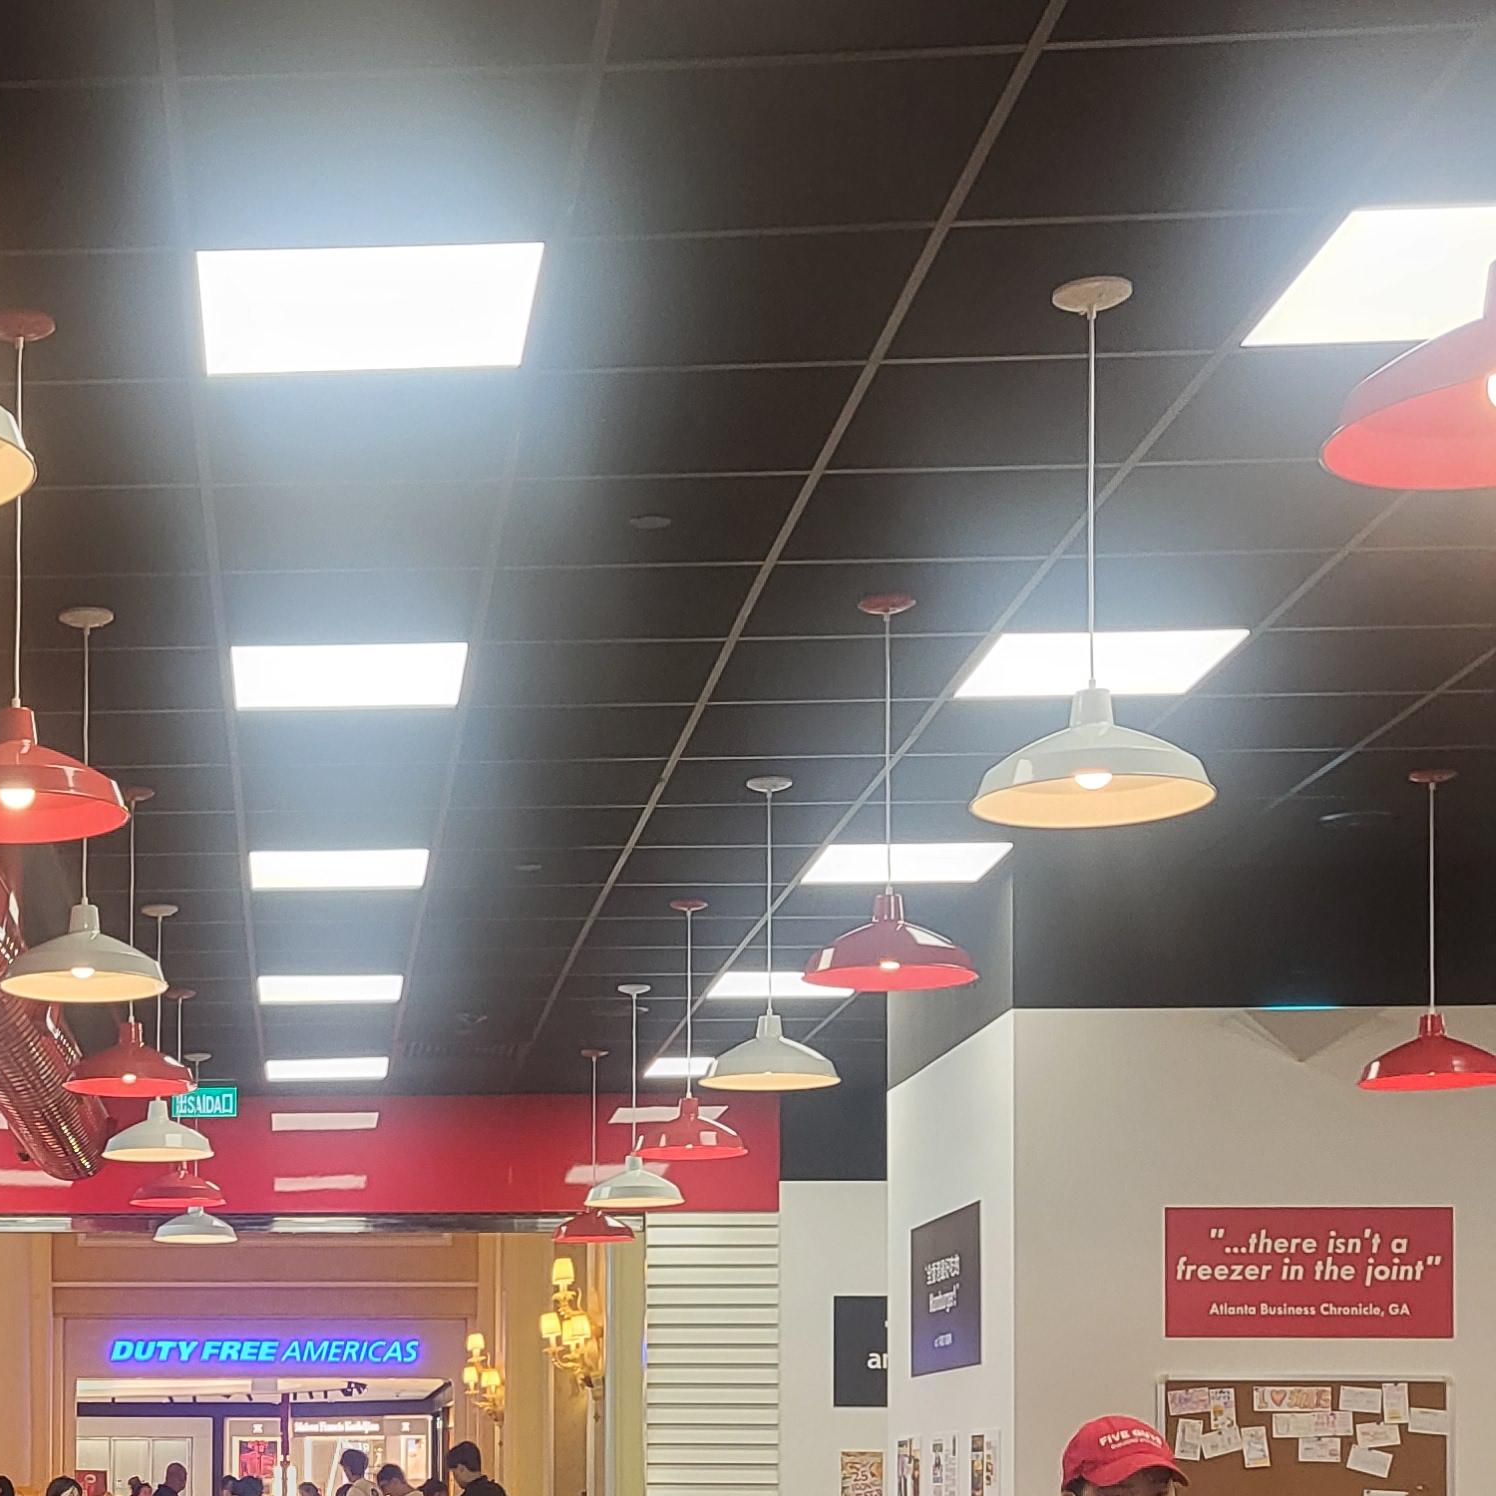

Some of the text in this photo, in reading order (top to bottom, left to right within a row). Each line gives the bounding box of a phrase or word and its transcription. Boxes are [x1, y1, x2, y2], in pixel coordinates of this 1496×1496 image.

[1327, 1228, 1381, 1254] isn't
[1391, 1238, 1408, 1254] a
[1176, 1256, 1272, 1281] freezer
[1281, 1257, 1304, 1281] in
[1314, 1256, 1356, 1281] the
[1209, 1303, 1410, 1317] Atlanta Business Chronicle, GA
[110, 1340, 419, 1363] DUTY FREE AMERICAS
[1099, 1430, 1130, 1447] FIVE
